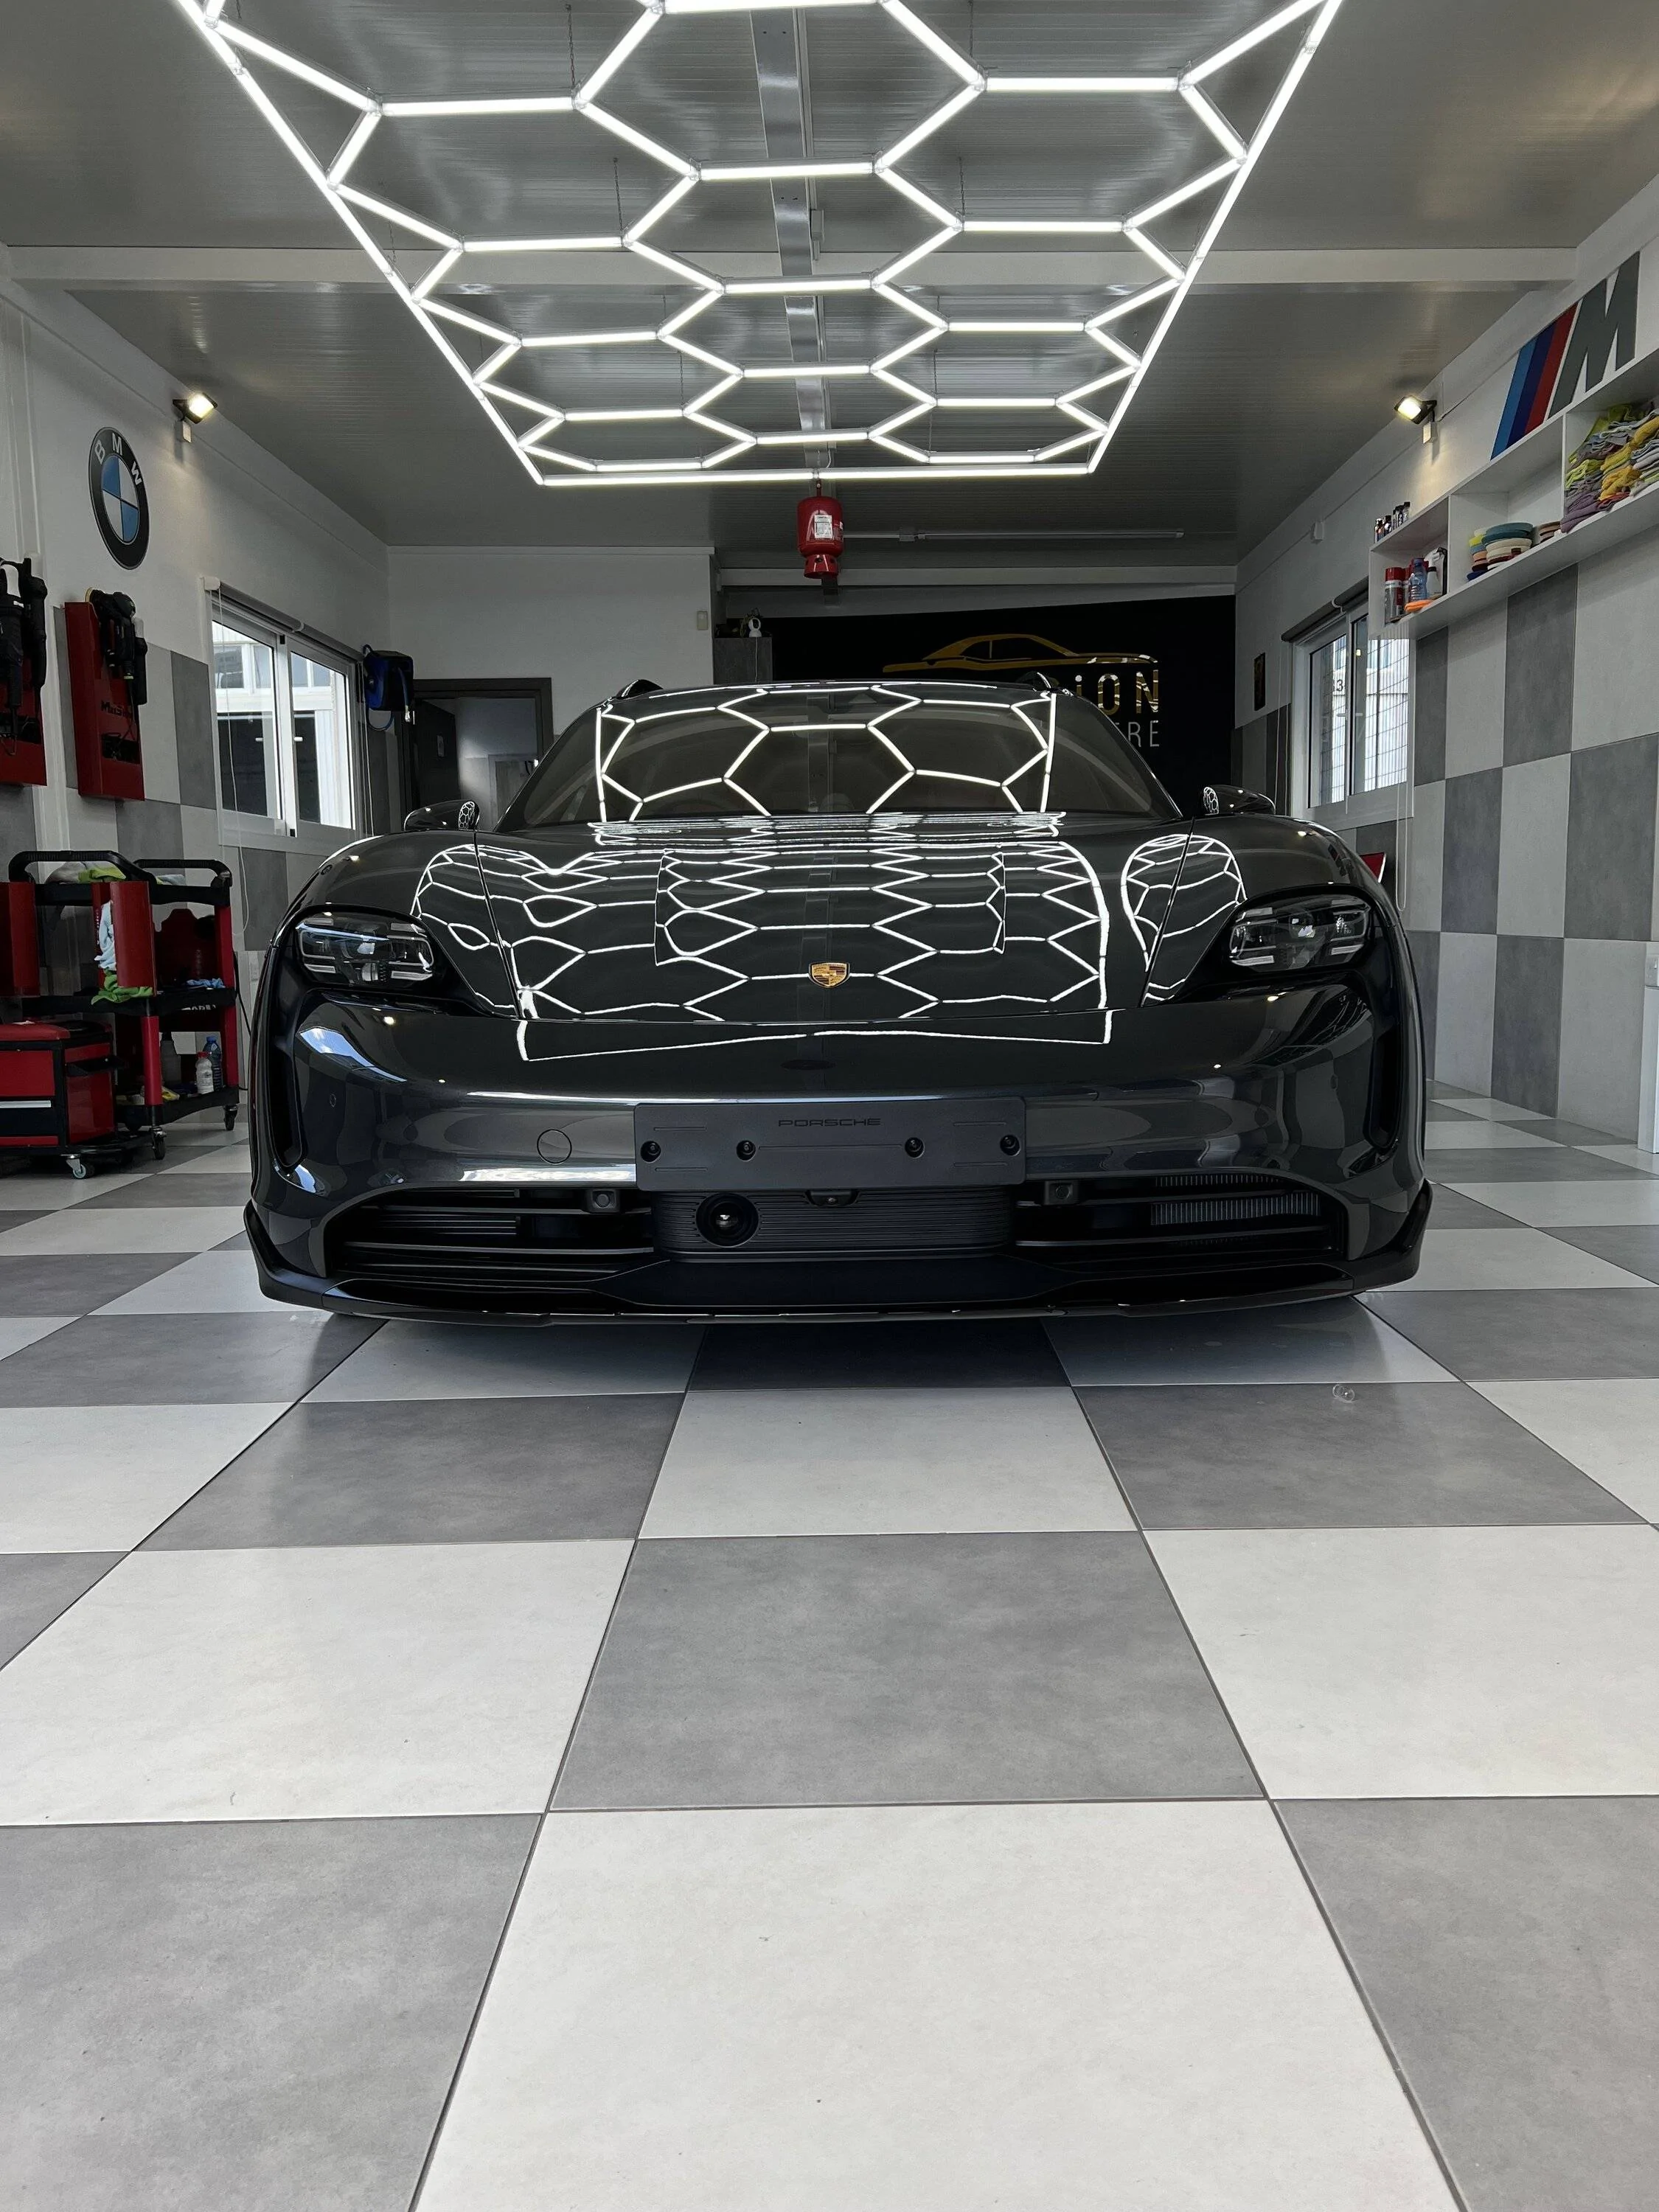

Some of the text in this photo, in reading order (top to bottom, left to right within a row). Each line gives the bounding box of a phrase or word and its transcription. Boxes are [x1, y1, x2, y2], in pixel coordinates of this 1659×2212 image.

[94, 432, 142, 485] BMW
[1049, 669, 1159, 715] iON
[1115, 720, 1160, 748] RE
[778, 1118, 881, 1127] PORSCHE
